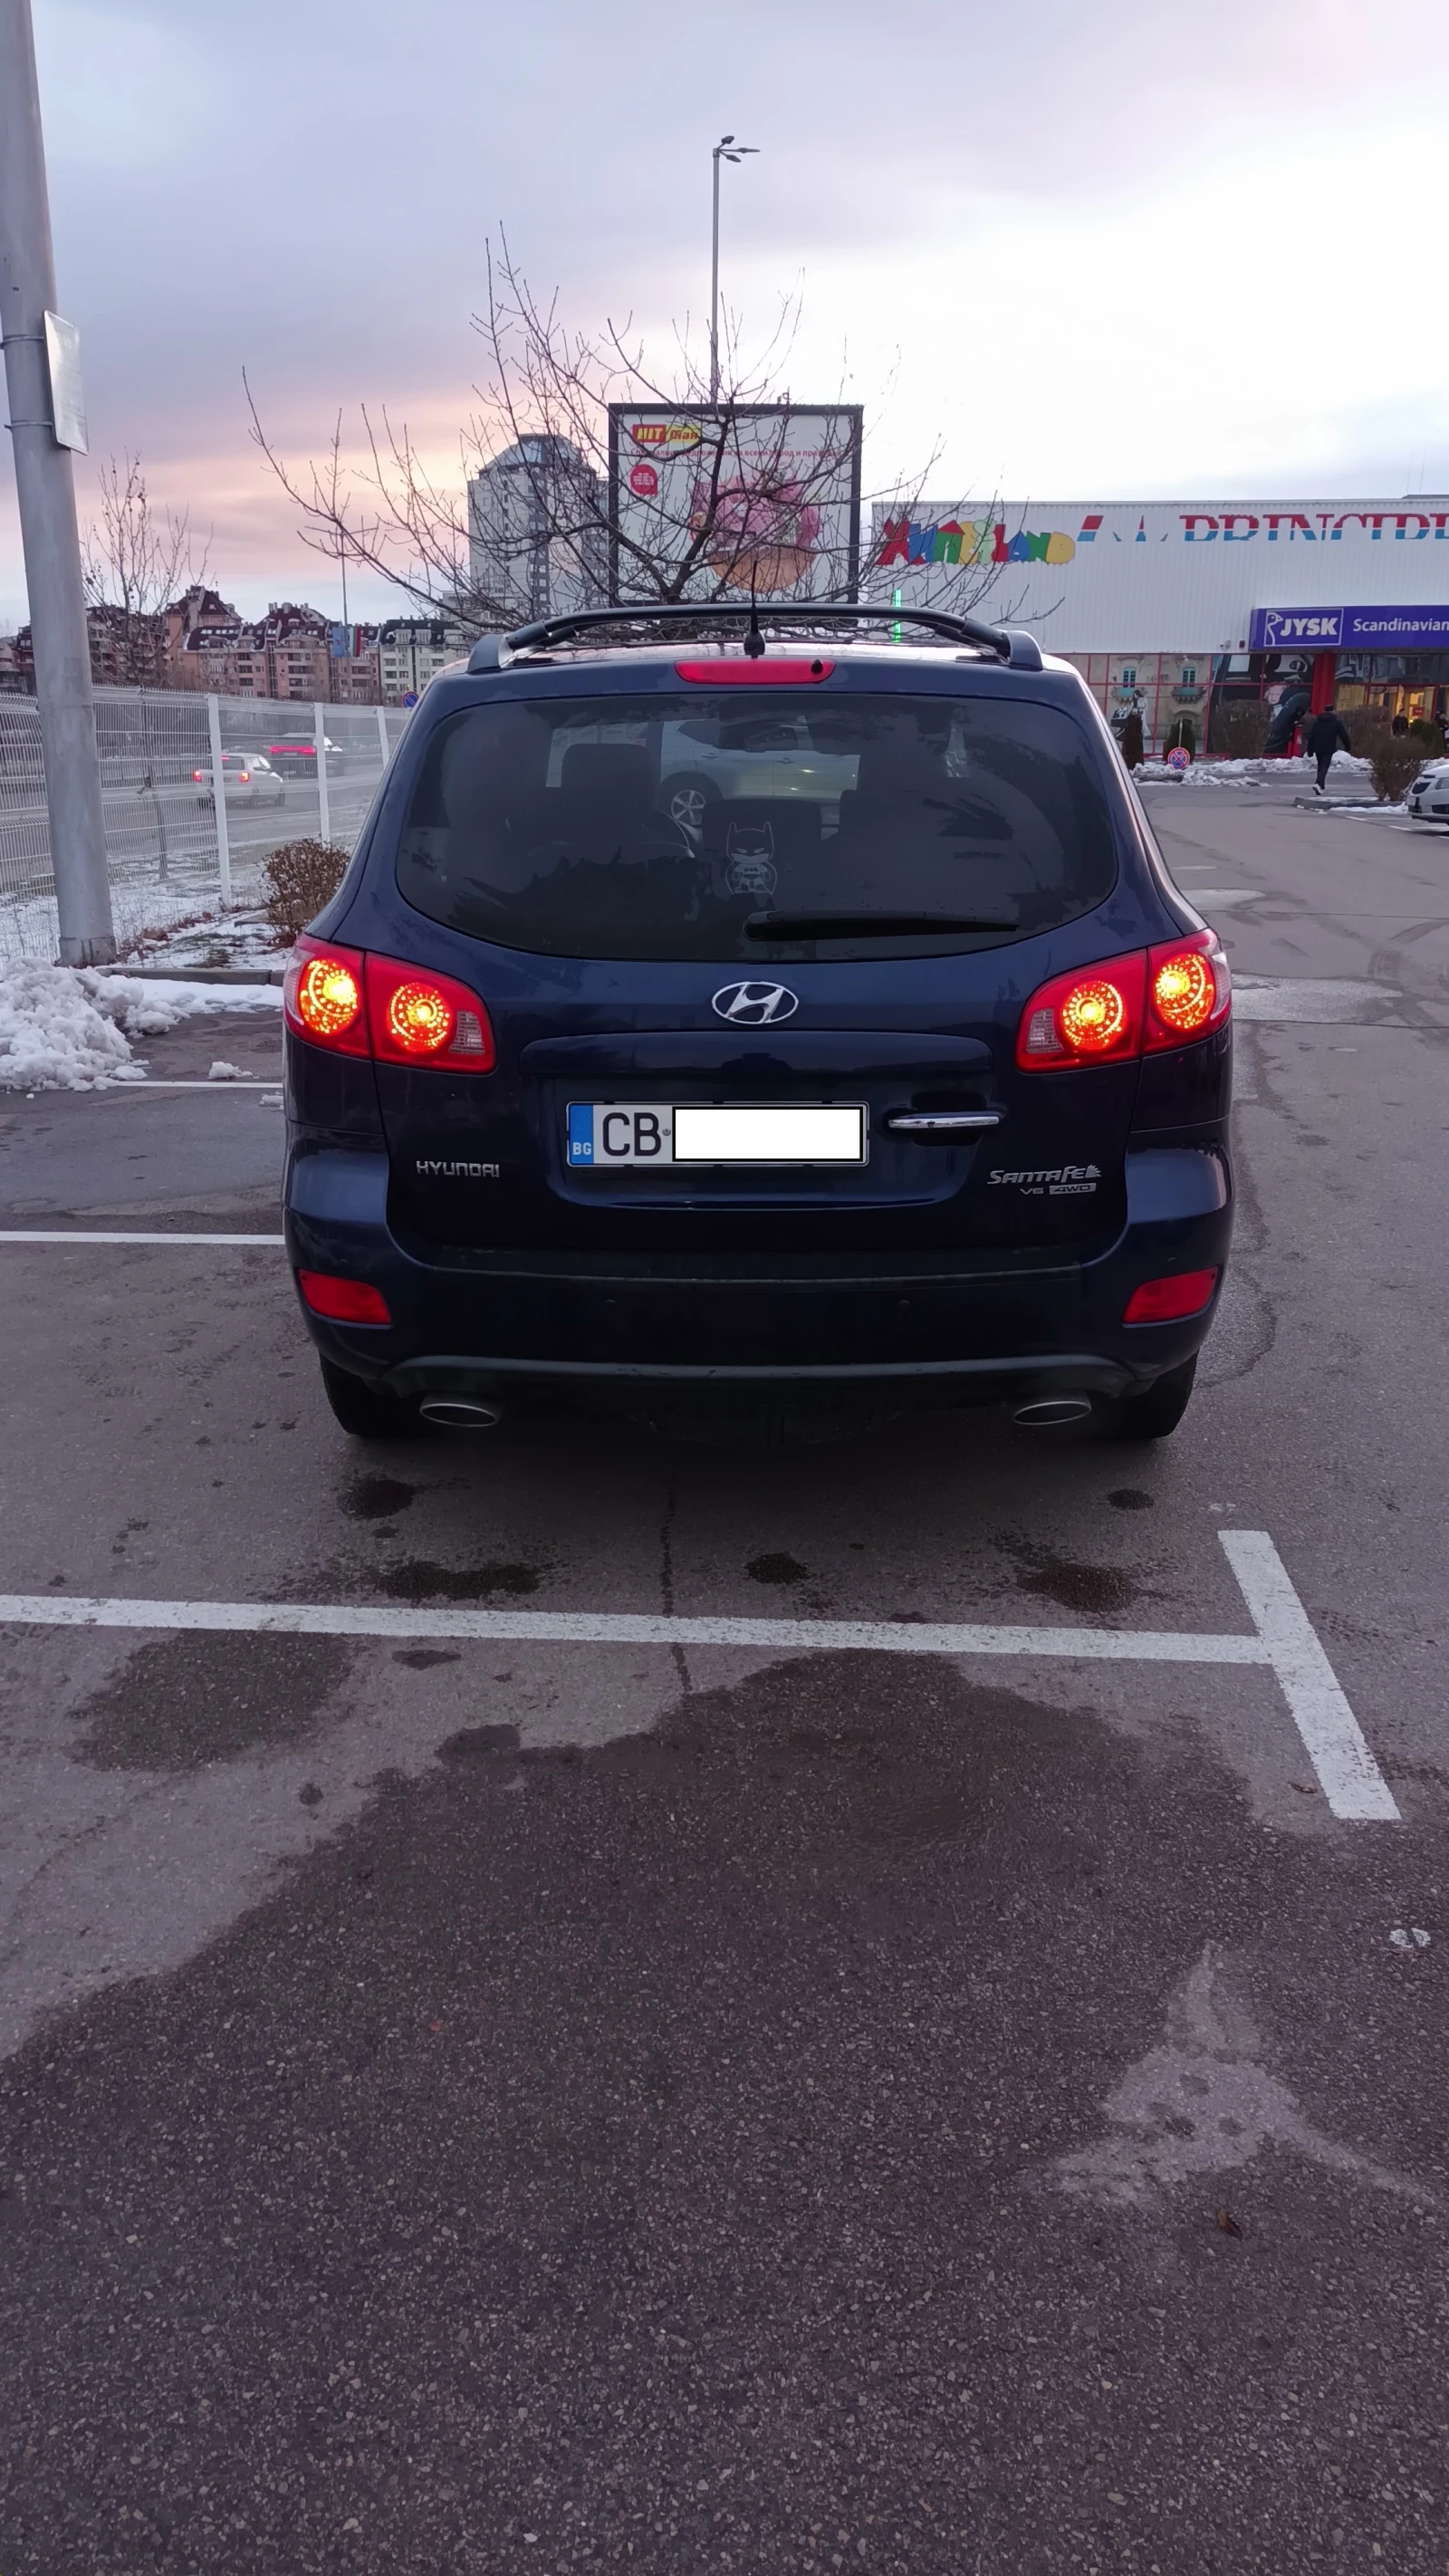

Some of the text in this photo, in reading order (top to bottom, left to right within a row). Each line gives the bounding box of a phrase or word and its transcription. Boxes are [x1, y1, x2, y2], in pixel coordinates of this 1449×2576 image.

[1280, 617, 1449, 637] JYSK Scandinavian
[572, 1141, 592, 1156] BG
[416, 1160, 500, 1178] HYUNDAI
[1052, 1184, 1091, 1194] 4WD
